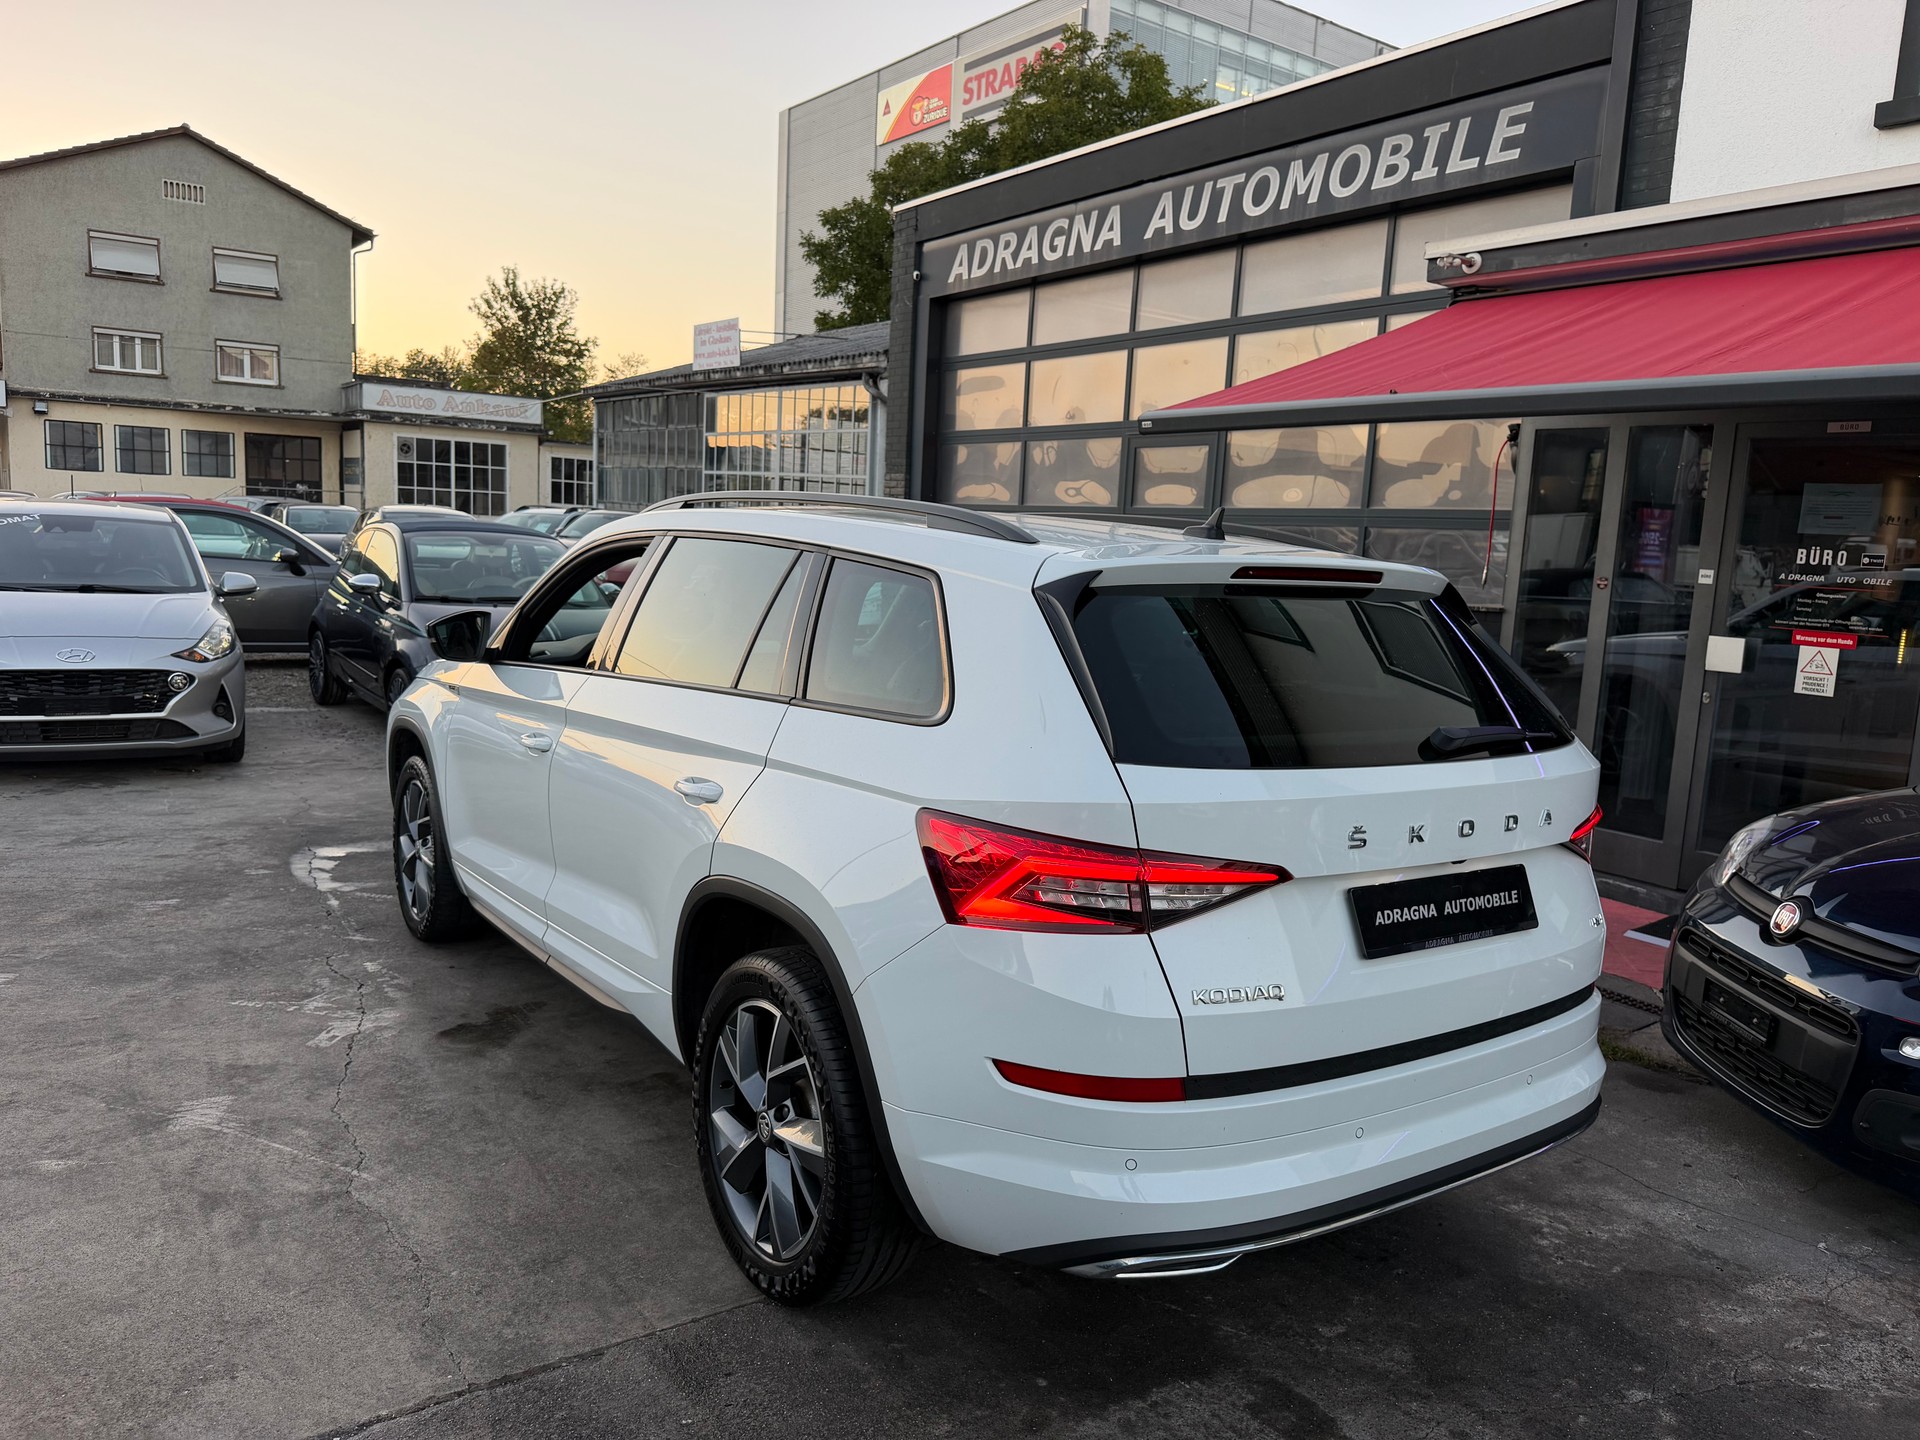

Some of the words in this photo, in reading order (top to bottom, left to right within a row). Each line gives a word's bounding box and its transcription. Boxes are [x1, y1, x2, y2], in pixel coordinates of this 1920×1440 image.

[962, 42, 1066, 106] STRAB
[948, 204, 1122, 284] ADRAGNA
[1143, 101, 1534, 240] AUTOMOBILE
[377, 389, 437, 410] Auto
[442, 396, 529, 420] Ankauf
[1839, 423, 1860, 431] BÜRO
[1796, 546, 1848, 567] BÜRO
[1795, 634, 1817, 643] Warnung
[1837, 637, 1854, 645] Hunde
[1347, 808, 1553, 850] ŠKODA
[1375, 903, 1438, 926] ADRAGNA
[1443, 890, 1519, 916] AUTOMOBILE
[1775, 909, 1795, 927] FIAT
[1191, 983, 1286, 1006] KODIAQ
